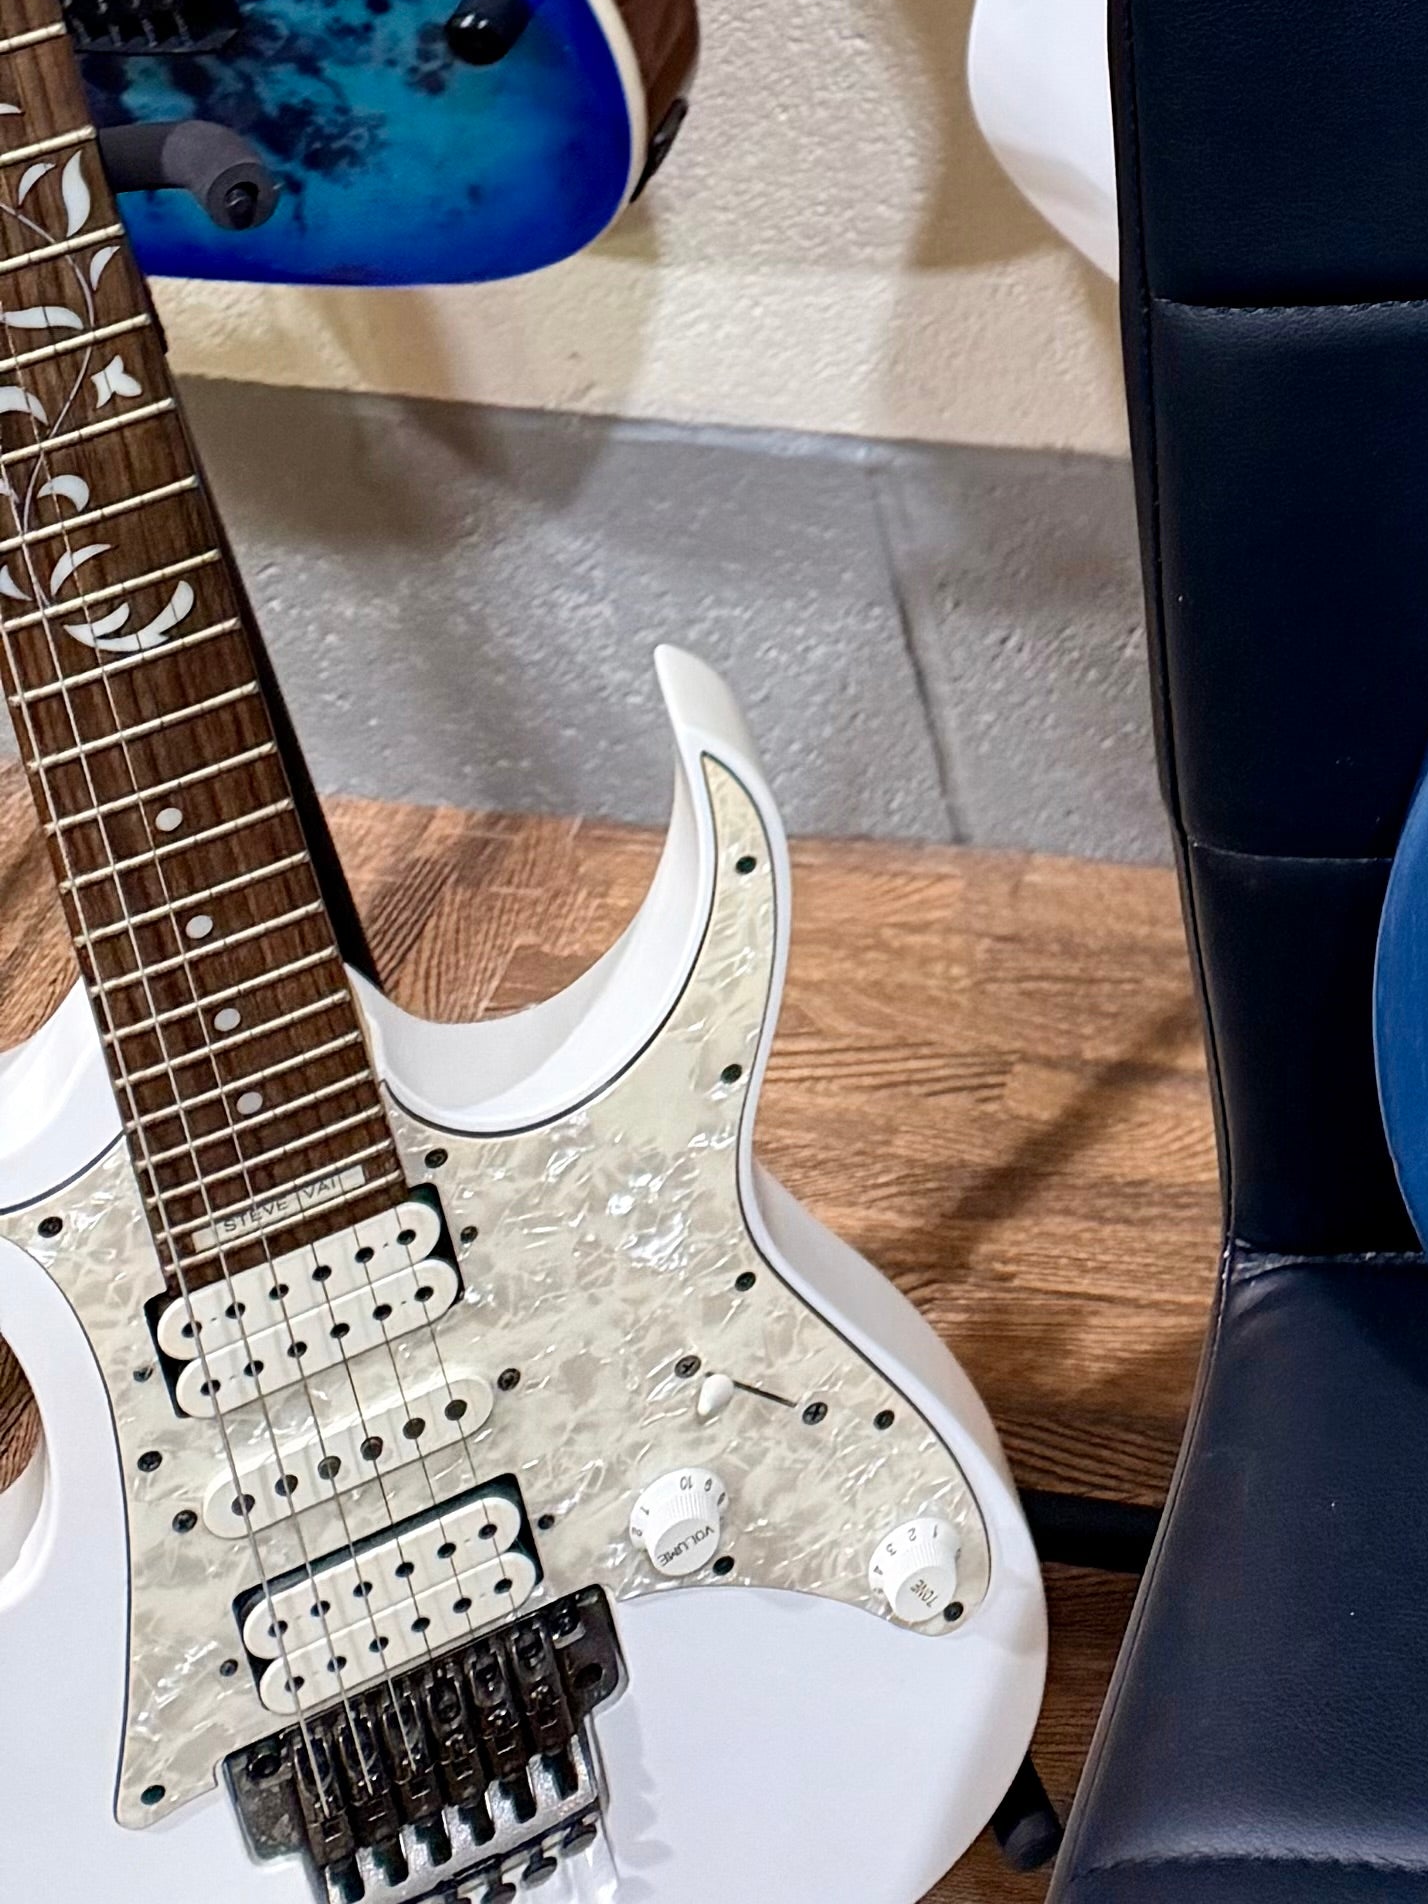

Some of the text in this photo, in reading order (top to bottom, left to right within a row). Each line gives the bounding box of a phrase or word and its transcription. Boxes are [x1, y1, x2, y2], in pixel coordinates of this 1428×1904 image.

[223, 1177, 337, 1233] STEVE VAI
[680, 1475, 693, 1490] 10
[657, 1525, 715, 1567] VOLUME
[910, 1579, 938, 1608] TONE
